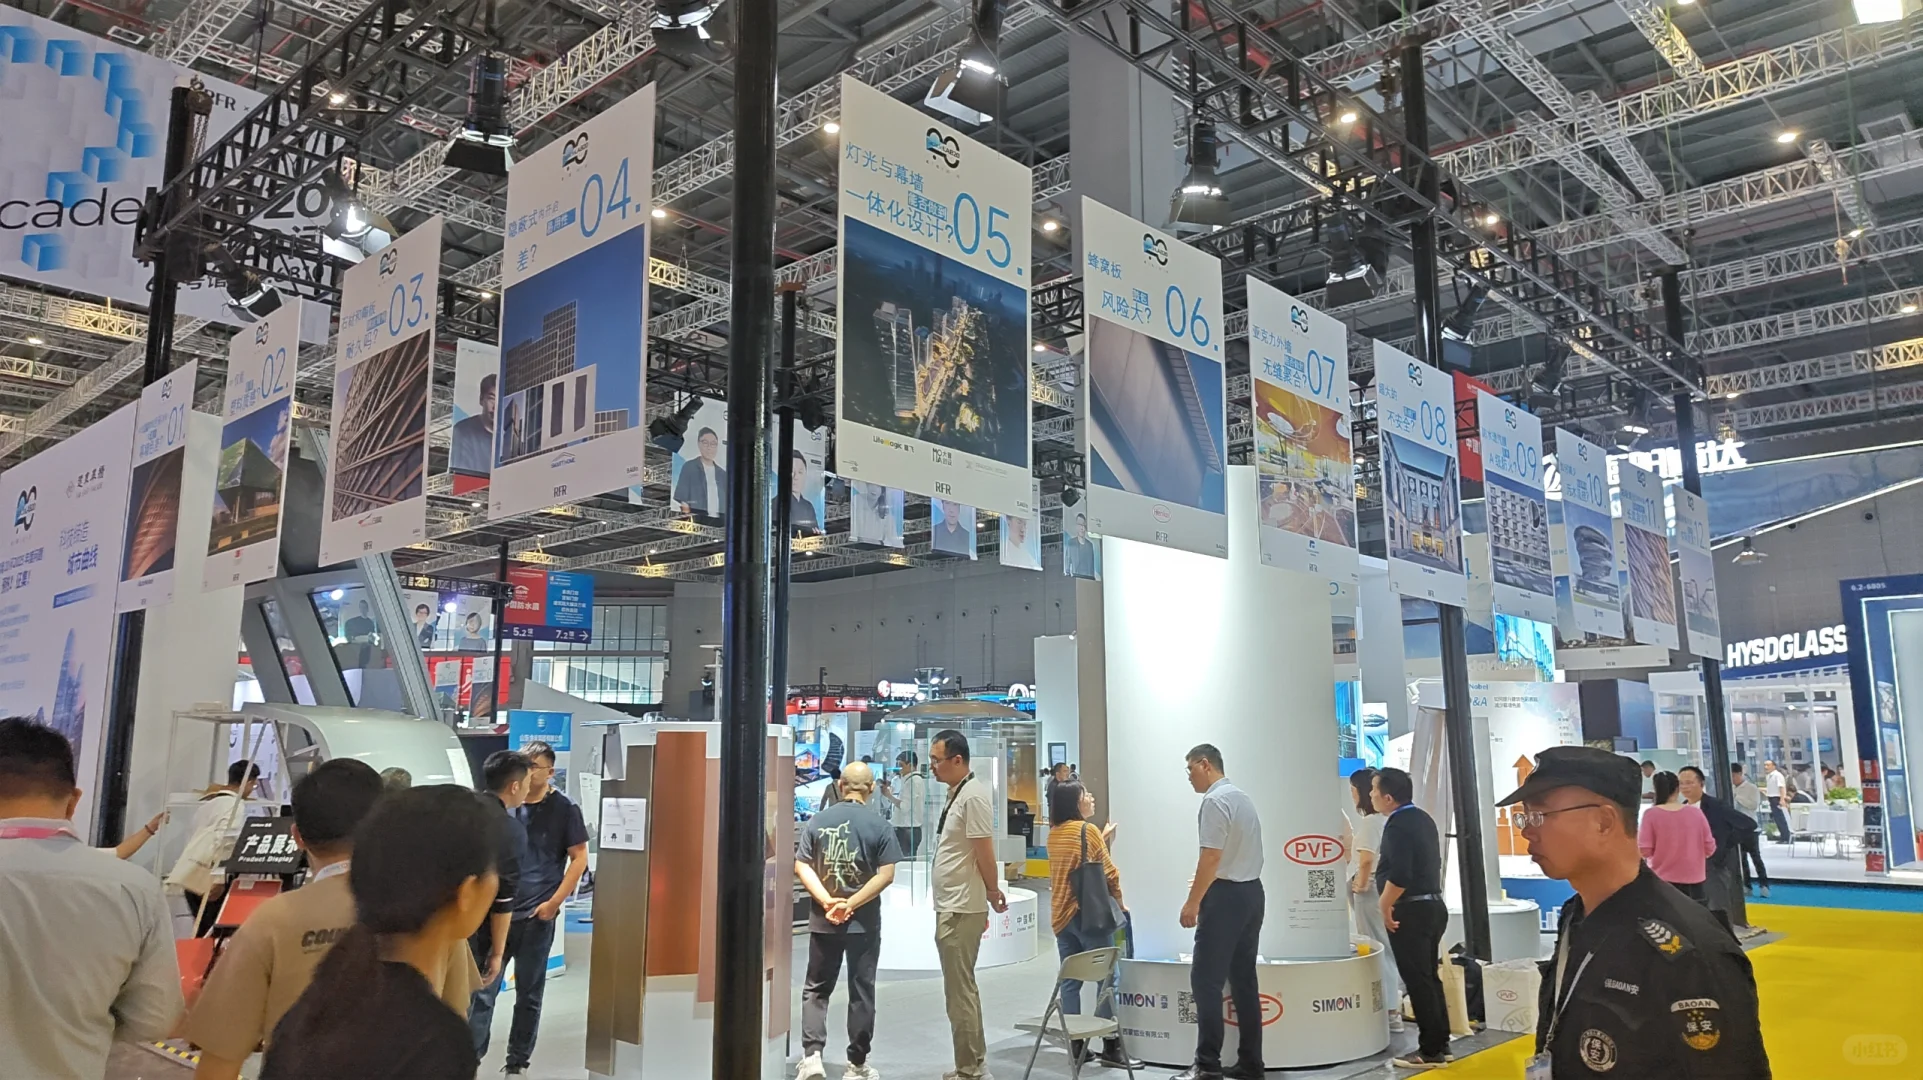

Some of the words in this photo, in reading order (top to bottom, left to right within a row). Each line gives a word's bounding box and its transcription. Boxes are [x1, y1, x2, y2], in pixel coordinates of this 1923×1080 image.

[845, 142, 924, 192] 灯光与幕墙
[580, 157, 641, 238] 04.
[845, 189, 953, 243] 一体化设计?
[954, 193, 1023, 275] 05.
[1087, 251, 1122, 280] 蜂窝板
[388, 272, 429, 337] 03.
[1101, 290, 1152, 324] 风险大?
[1165, 285, 1219, 352] 06.
[1252, 324, 1293, 354] 亚克力外墙
[1307, 349, 1340, 403] 07.
[1420, 400, 1453, 449] 08.
[935, 481, 951, 496] RFR
[238, 855, 266, 863] Product
[267, 855, 294, 864] Display
[241, 834, 299, 855] 产品展示
[1295, 842, 1333, 859] PVF
[1312, 996, 1353, 1013] SIMON
[1678, 1000, 1712, 1009] BAOAN
[1686, 1020, 1713, 1033] 保安
